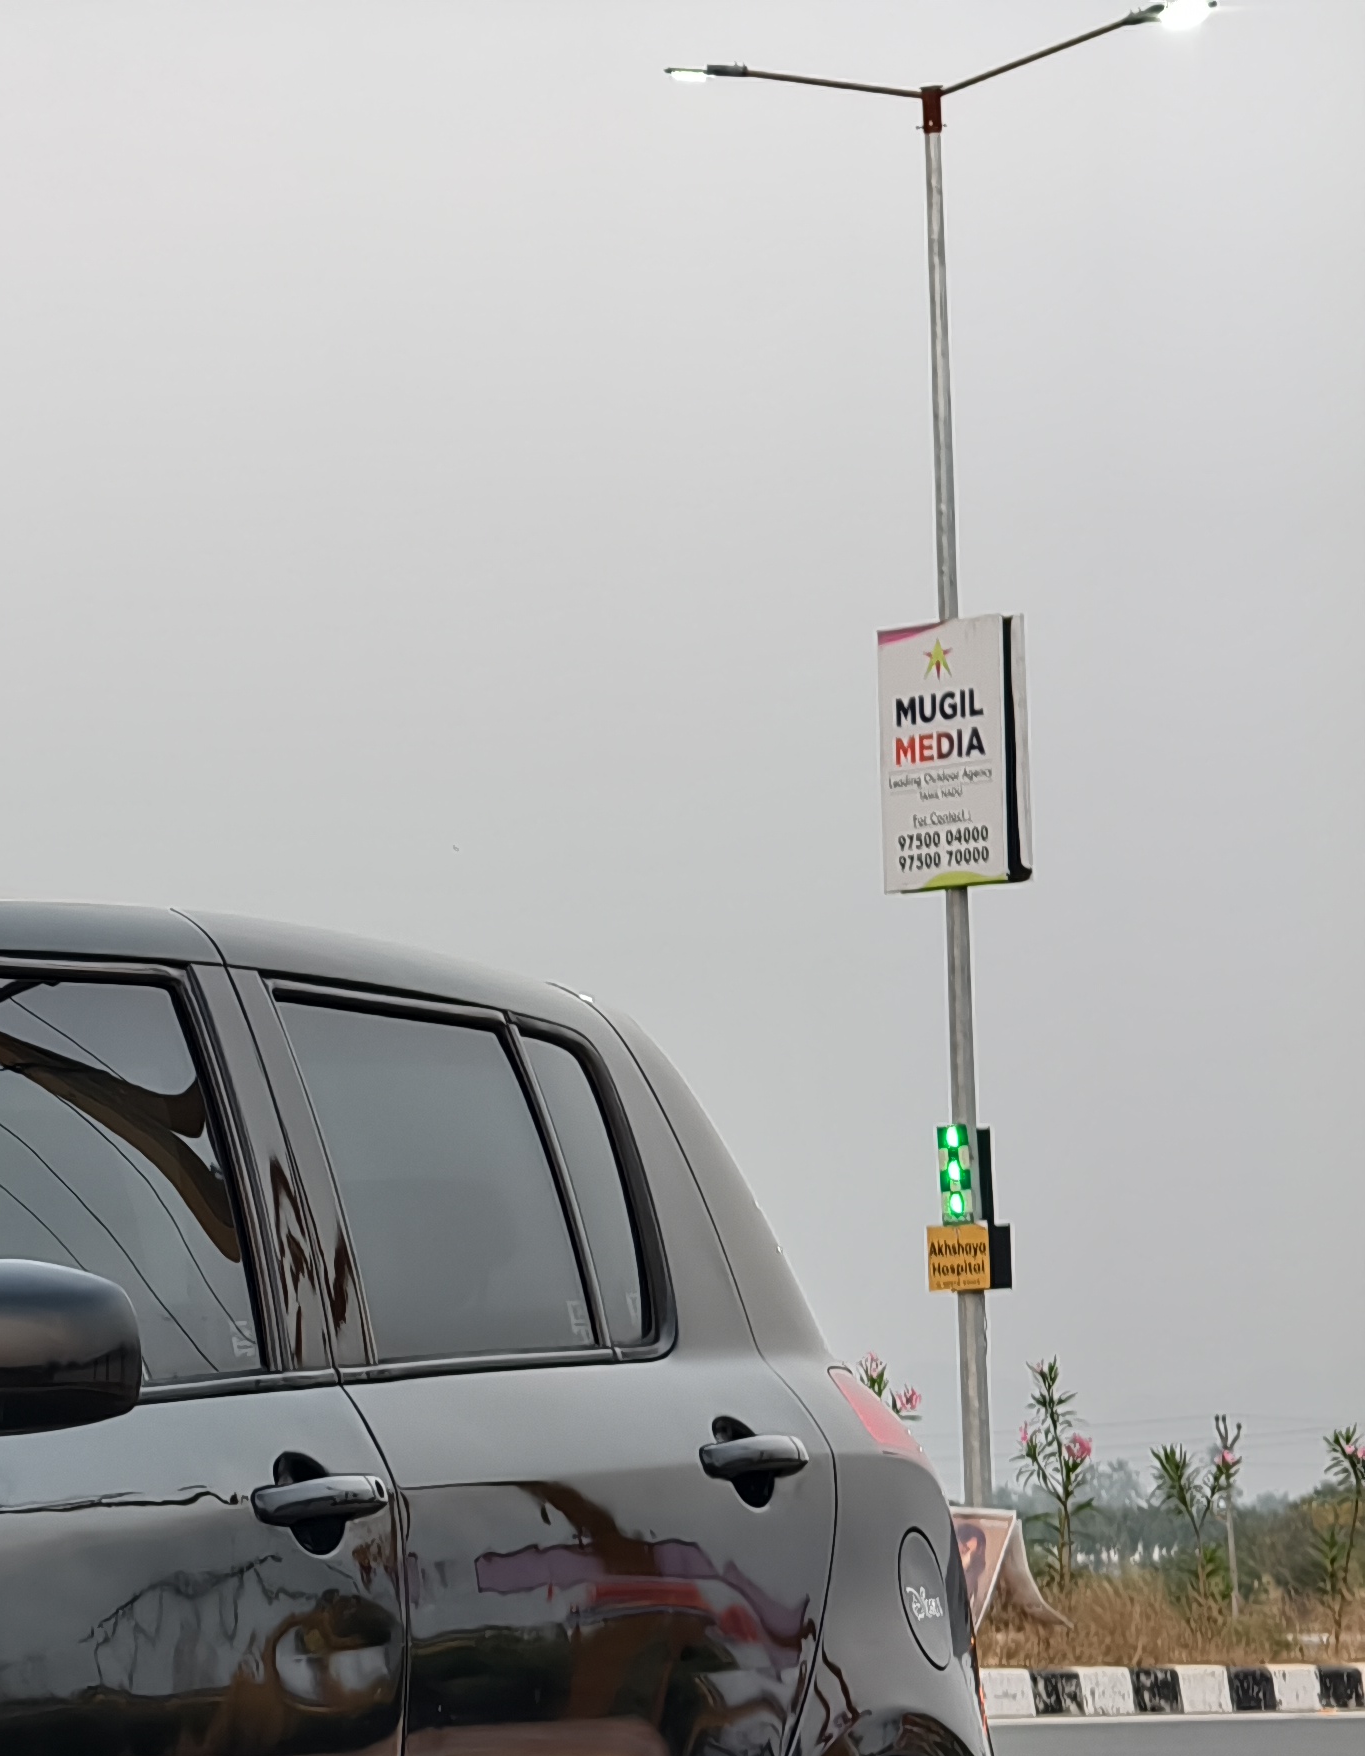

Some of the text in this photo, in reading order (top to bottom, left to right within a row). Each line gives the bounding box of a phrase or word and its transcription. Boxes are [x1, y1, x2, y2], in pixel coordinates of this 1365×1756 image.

[895, 688, 984, 727] MUGIL
[895, 727, 986, 767] MEDIA
[898, 825, 989, 851] 97500 04000
[898, 846, 989, 873] 97500 70000
[929, 1238, 987, 1260] Akhshaya
[931, 1257, 986, 1279] Hospital
